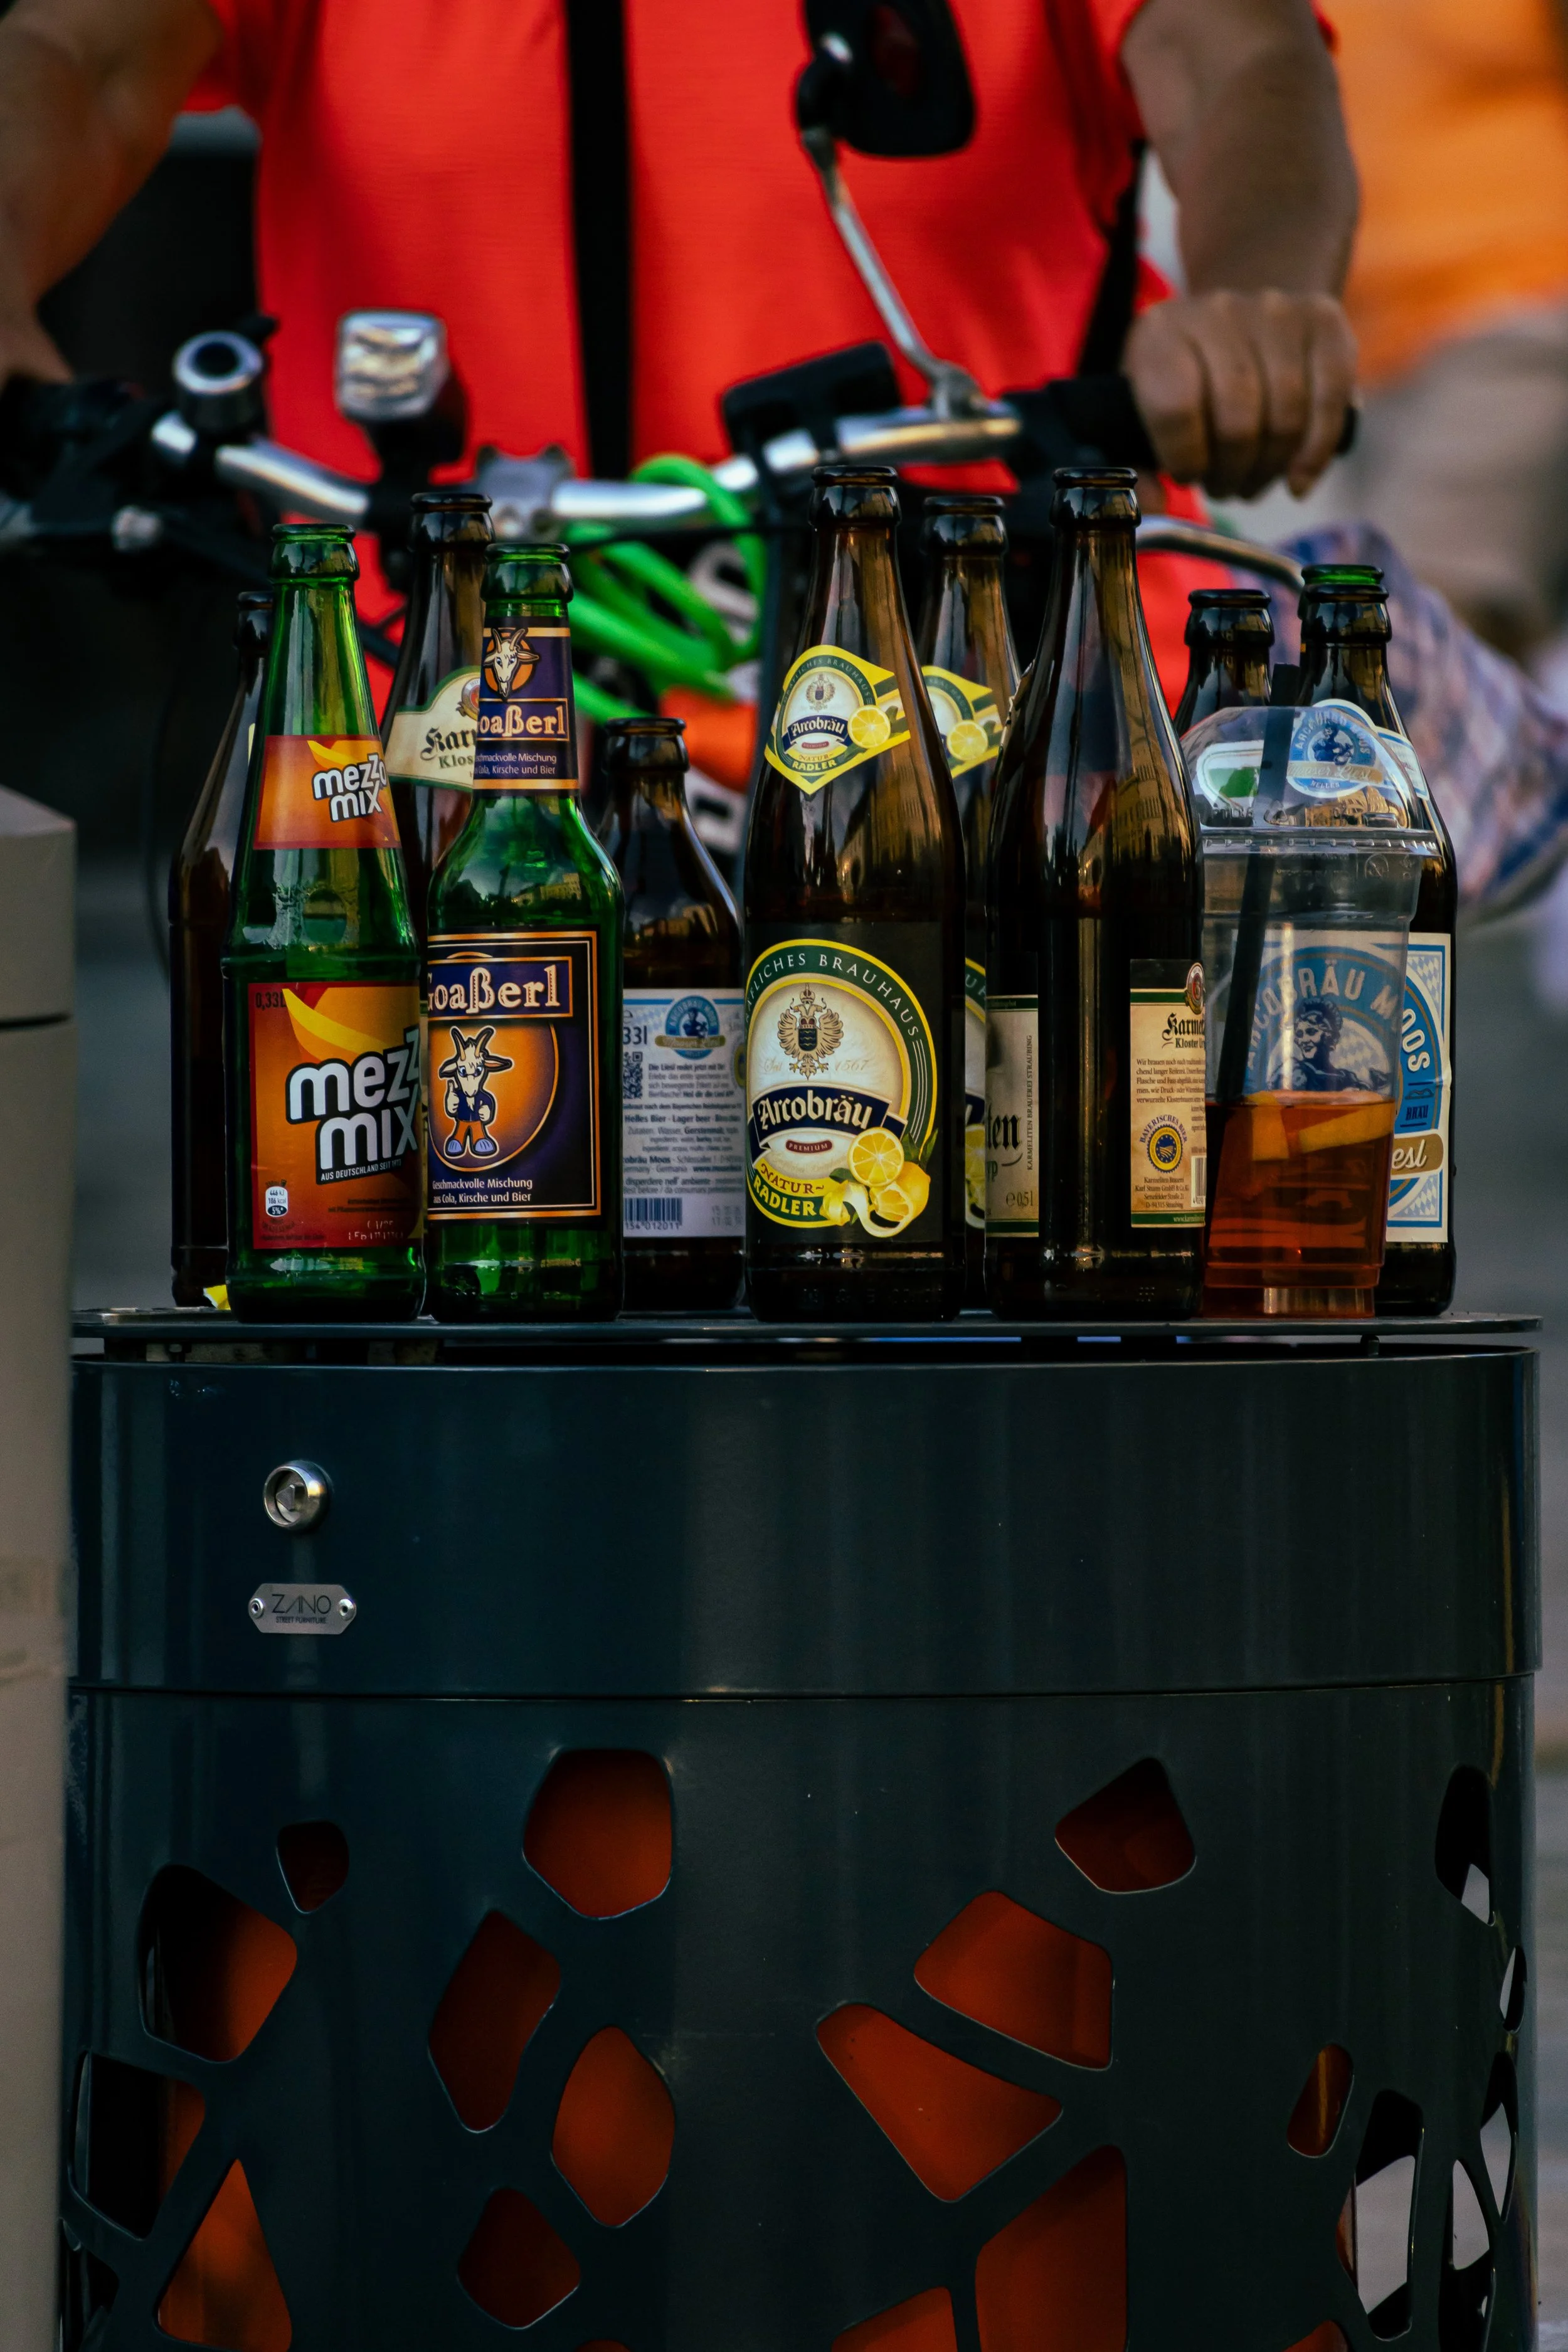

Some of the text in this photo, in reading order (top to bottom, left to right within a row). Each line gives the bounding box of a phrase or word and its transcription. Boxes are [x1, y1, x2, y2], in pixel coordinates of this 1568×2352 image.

[827, 658, 871, 696] BRAUHAUS
[479, 704, 566, 737] oaßerl
[790, 716, 845, 736] Arcobräu
[518, 752, 557, 764] Mischung
[792, 759, 837, 771] RADLER
[313, 754, 387, 799] mezzo
[492, 764, 519, 774] Kirsche
[522, 765, 538, 774] und
[540, 765, 556, 775] Bier
[331, 781, 382, 822] mix
[818, 953, 918, 1036] BRAUHAUS
[1175, 1038, 1198, 1048] Kloster
[758, 1089, 872, 1130] Arcobräu
[320, 1084, 418, 1170] mix
[1140, 1115, 1179, 1143] BAYERISCHES
[788, 1142, 828, 1152] PREMIUM
[320, 1172, 334, 1181] AUS
[336, 1164, 379, 1179] DEUTSCHLAND
[379, 1160, 391, 1170] SEIT
[432, 1177, 532, 1190] Geschmackvolle Mischung
[442, 1192, 457, 1204] Cola,
[459, 1192, 488, 1203] Kirsche
[490, 1191, 509, 1202] und
[512, 1192, 532, 1202] Bier
[753, 1174, 817, 1216] RADLER
[272, 1594, 331, 1614] ZANO
